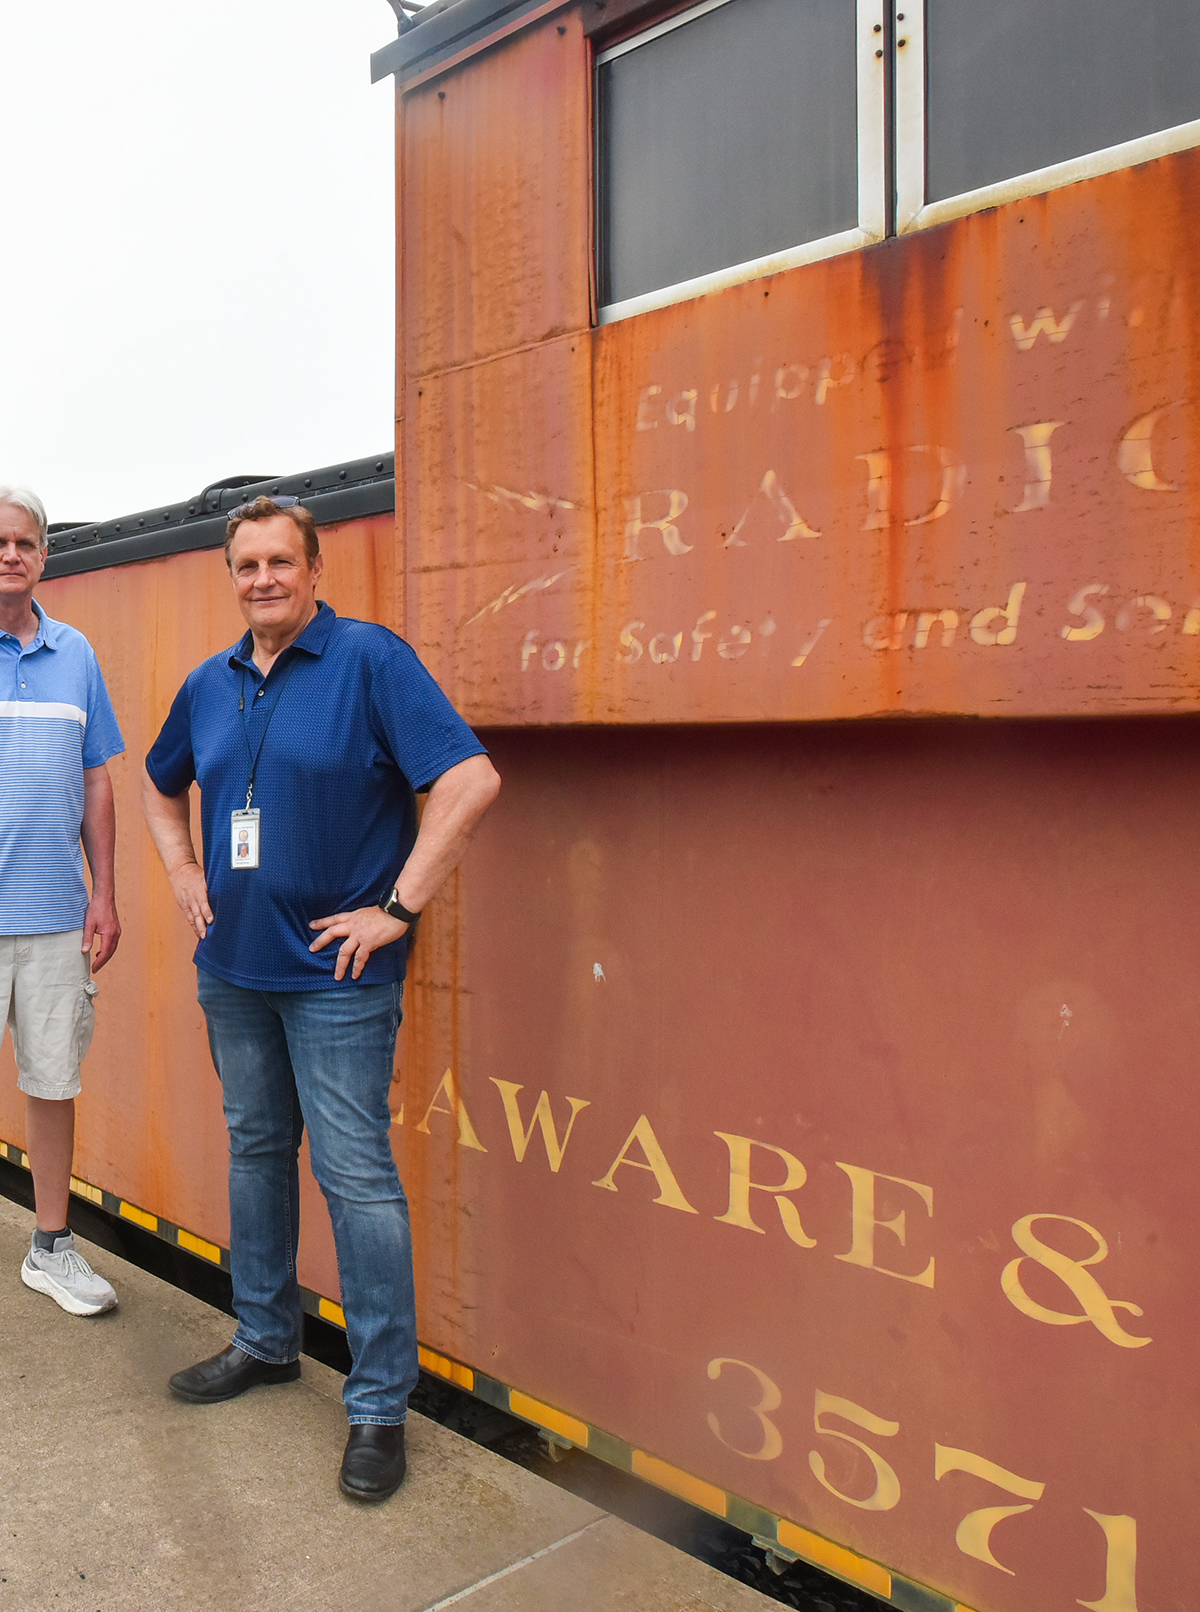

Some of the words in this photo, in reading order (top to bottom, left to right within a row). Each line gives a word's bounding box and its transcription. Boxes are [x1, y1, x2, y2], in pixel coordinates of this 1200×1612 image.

[616, 610, 833, 667] Safey
[863, 581, 1028, 650] and
[390, 1066, 936, 1290] AWARE
[1000, 1213, 1154, 1349] &
[706, 1356, 1138, 1612] 3571
